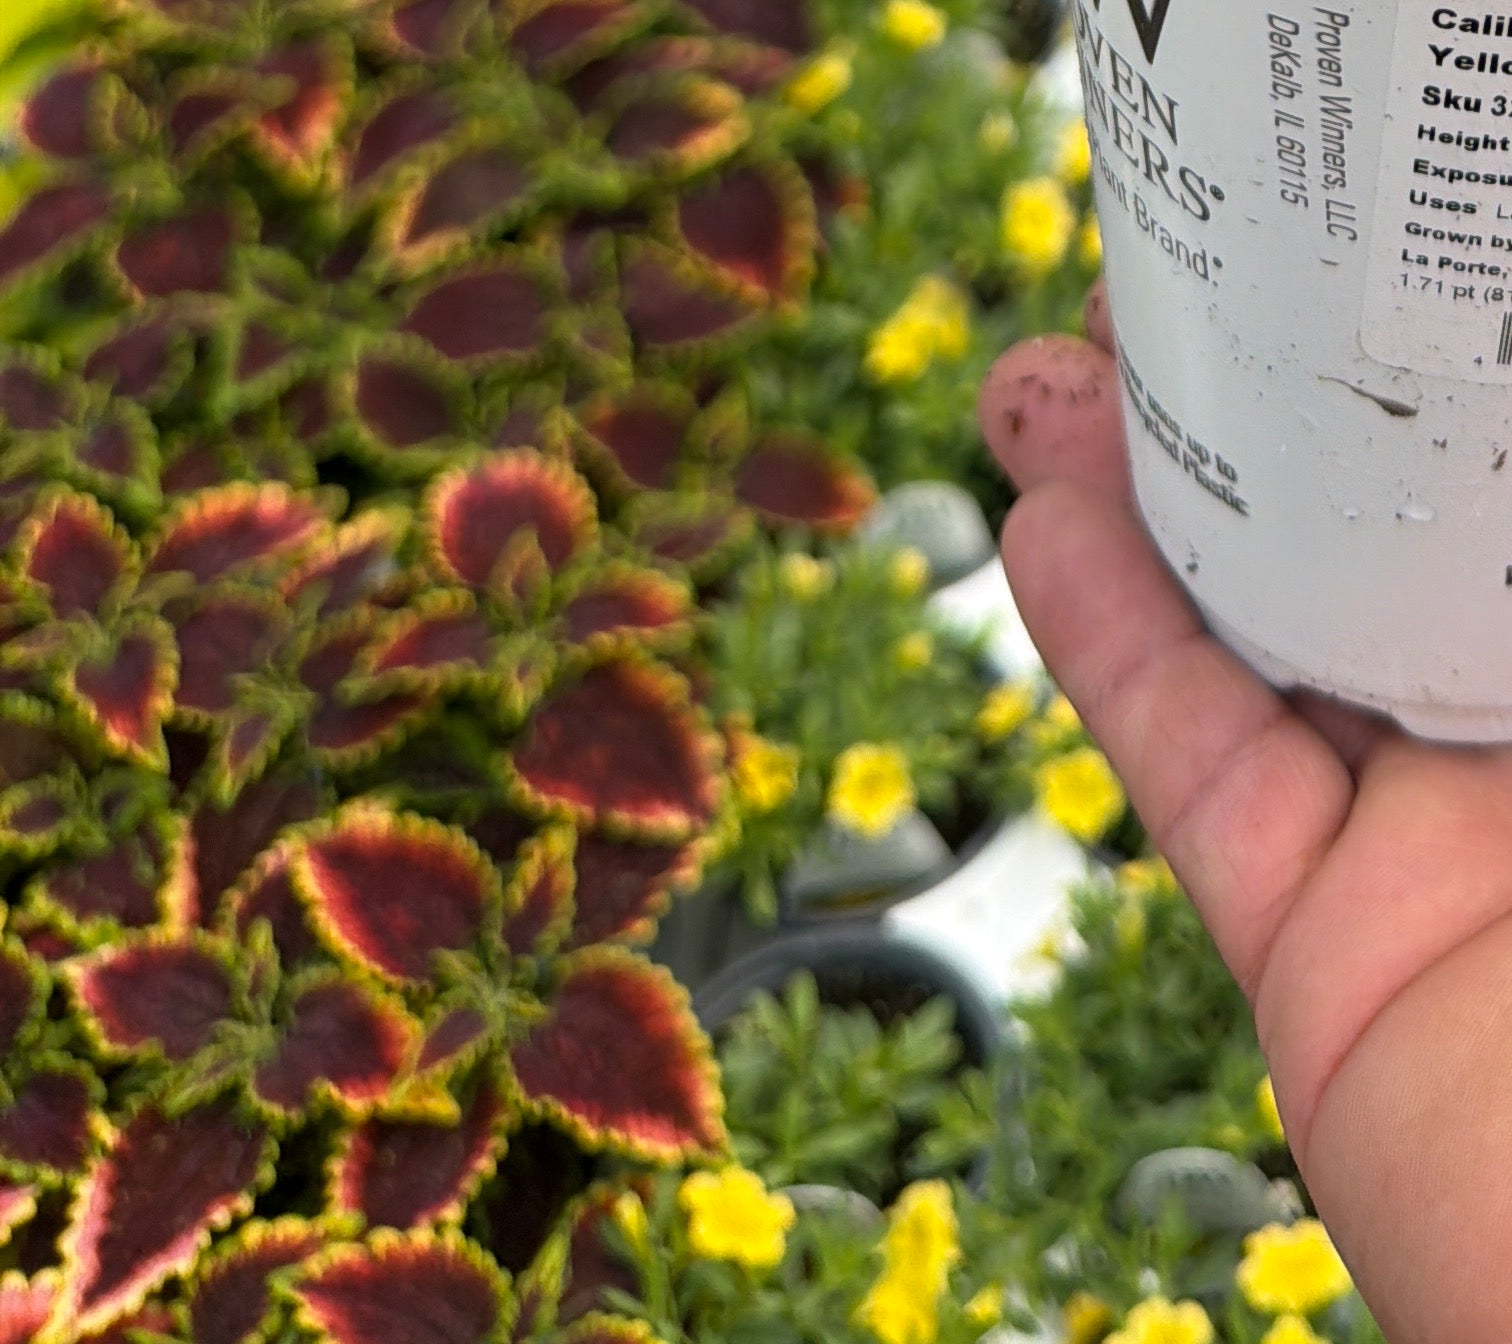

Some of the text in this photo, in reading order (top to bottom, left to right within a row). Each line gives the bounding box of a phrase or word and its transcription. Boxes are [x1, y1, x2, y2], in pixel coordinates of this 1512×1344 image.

[1267, 12, 1309, 210] DeKalb, IL 60115
[1421, 85, 1482, 113] Sku
[1313, 6, 1358, 242] Proven Winners, LLC
[1417, 124, 1511, 152] Height
[1409, 189, 1478, 215] Uses
[1404, 221, 1483, 247] Grown
[1401, 248, 1430, 267] La
[1438, 255, 1509, 281] Porte,
[1400, 272, 1444, 295] 1.71
[1453, 284, 1476, 302] pt
[1186, 431, 1212, 465] up
[1214, 452, 1239, 484] to
